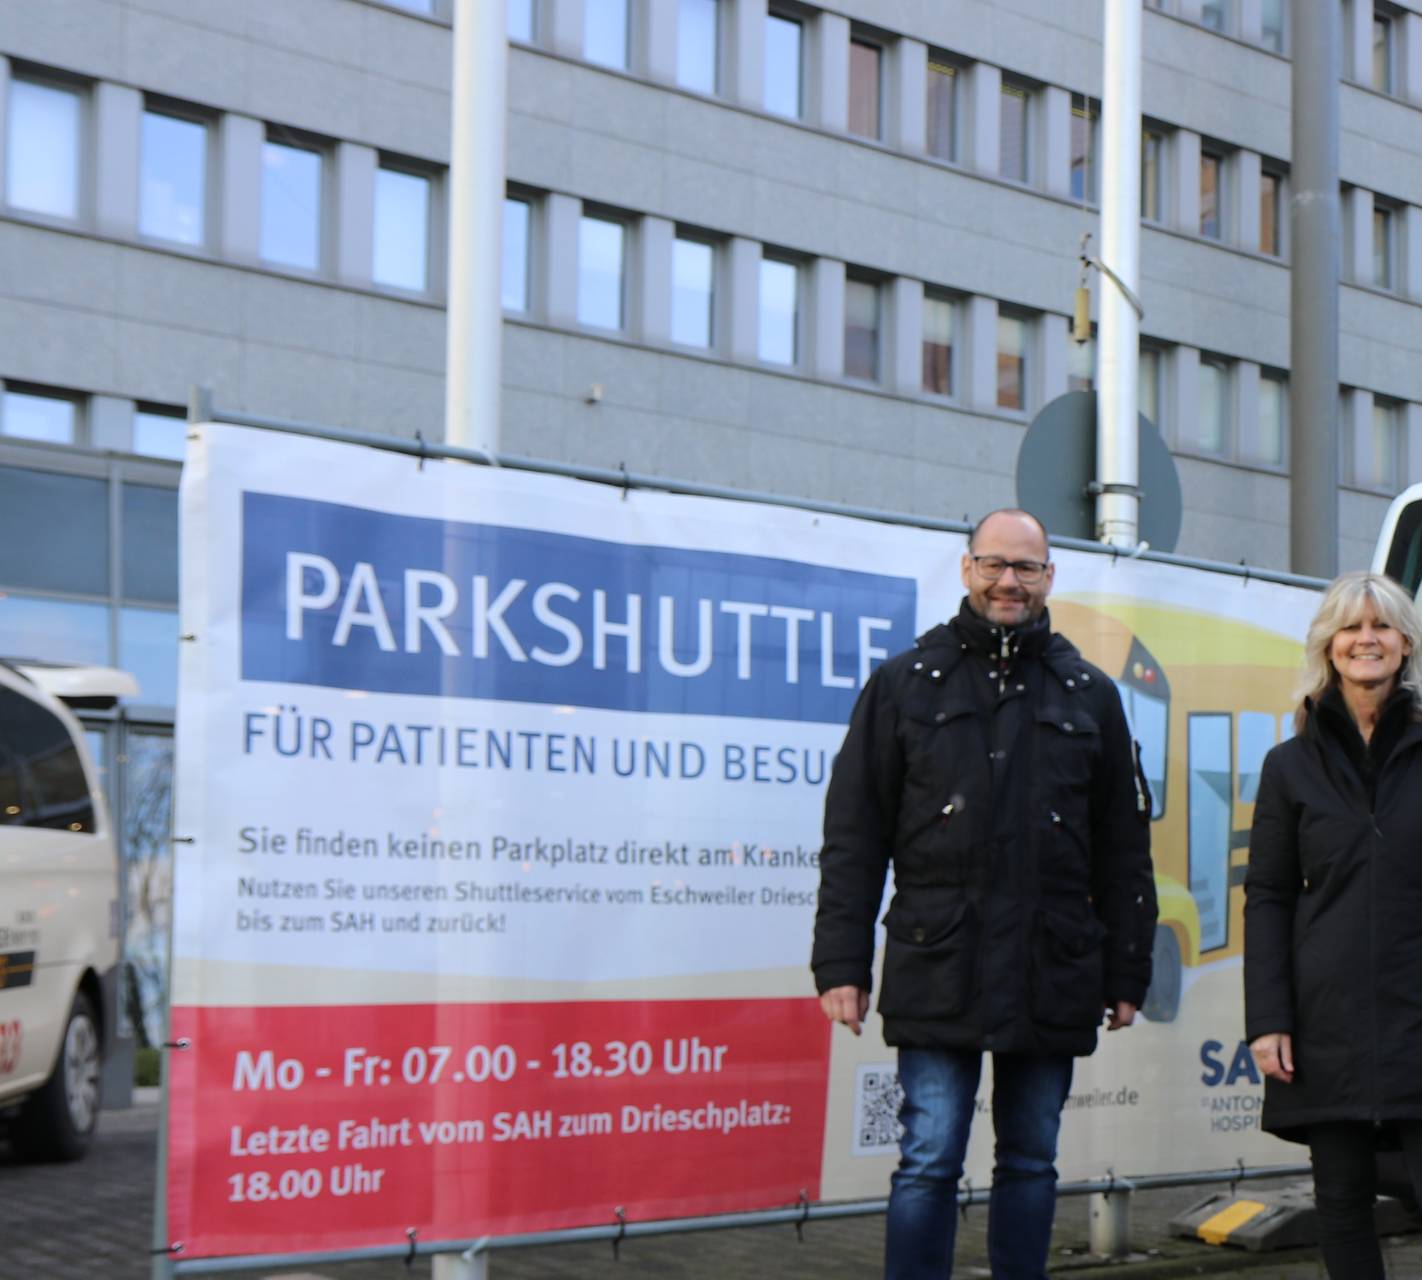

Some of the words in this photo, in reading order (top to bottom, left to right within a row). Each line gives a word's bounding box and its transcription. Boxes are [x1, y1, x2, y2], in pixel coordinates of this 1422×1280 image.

[244, 704, 333, 760] FÜR
[350, 720, 597, 775] PATIENTEN
[612, 738, 706, 779] UND
[238, 826, 288, 854] Sie
[296, 828, 379, 857] finden
[387, 832, 482, 860] keinen
[491, 836, 609, 867] Parkplatz
[615, 840, 690, 866] direkt
[699, 849, 735, 866] am
[238, 877, 318, 899] Nutzen
[324, 878, 357, 900] Sie
[362, 883, 449, 901] unseren
[454, 881, 601, 904] Shuttleservice
[606, 888, 644, 905] vom
[651, 884, 755, 906] Eschweiler
[236, 910, 273, 932] bis
[280, 914, 324, 933] zum
[330, 911, 374, 933] SAH
[382, 911, 420, 933] und
[427, 912, 507, 933] zurück!
[232, 1050, 304, 1091] Mo
[343, 1047, 392, 1087] Fr:
[402, 1044, 517, 1085] 07.00
[552, 1040, 653, 1079] 18.30
[663, 1035, 728, 1075] Uhr
[230, 1124, 331, 1157] Letzte
[338, 1117, 412, 1150] Fahrt
[419, 1119, 485, 1145] vom
[491, 1110, 552, 1142] SAH
[558, 1112, 613, 1138] zum
[620, 1099, 791, 1135] Drieschplatz:
[228, 1168, 322, 1202] 18.00
[330, 1163, 385, 1196] Uhr
